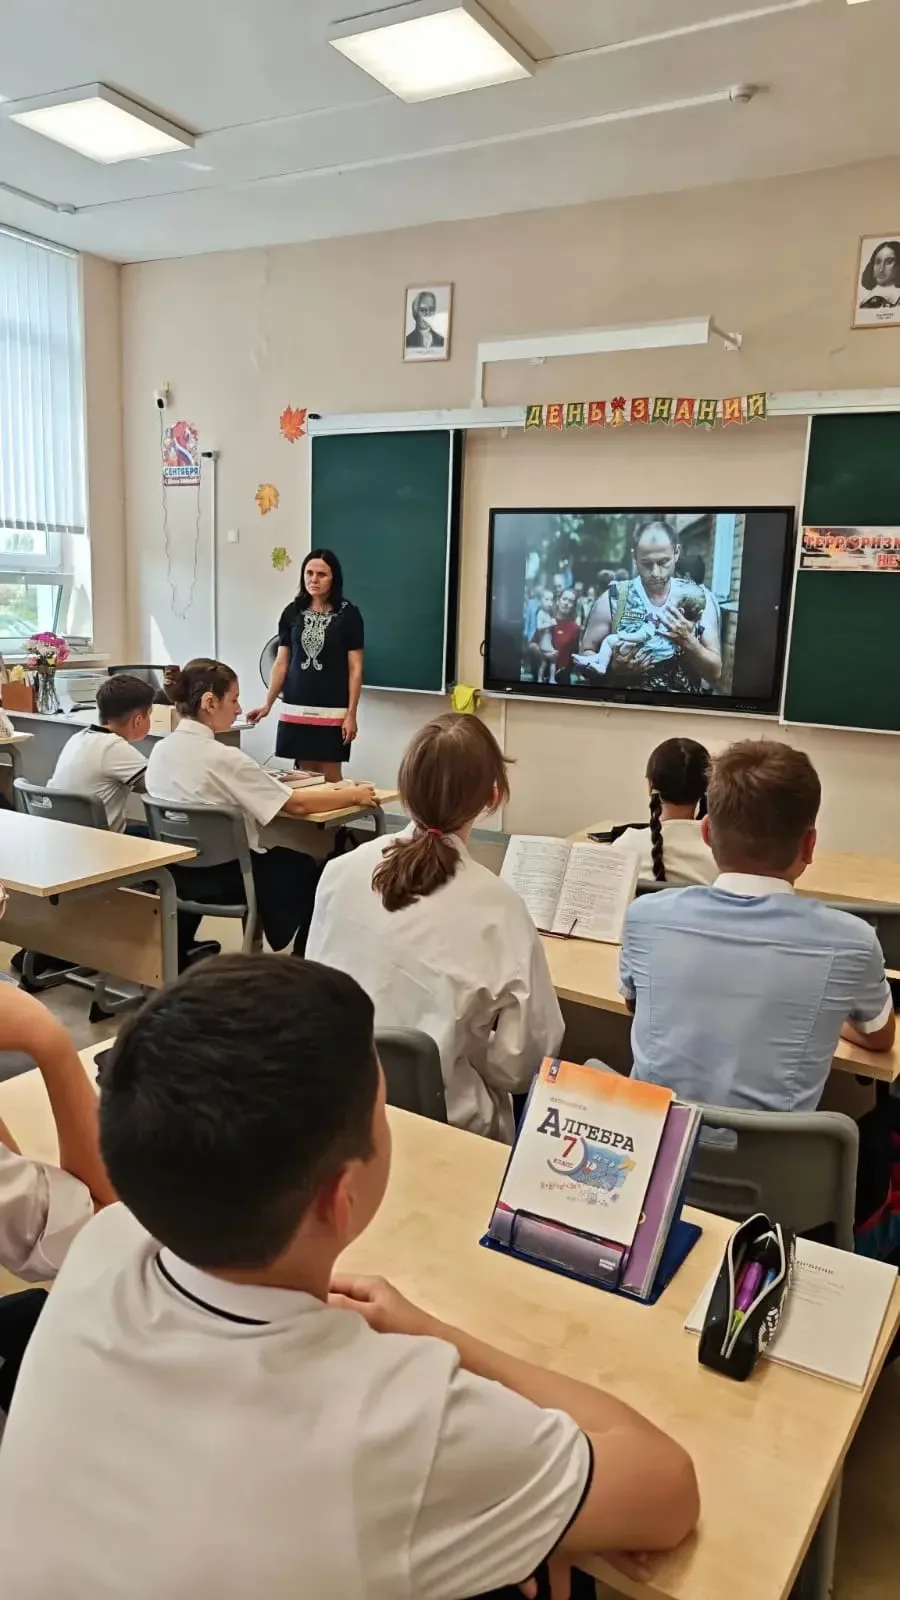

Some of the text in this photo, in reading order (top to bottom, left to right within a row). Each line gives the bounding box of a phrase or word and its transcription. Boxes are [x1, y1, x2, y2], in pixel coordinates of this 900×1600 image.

[527, 394, 766, 426] ДЕНЬ ЗНАНИЙ
[164, 466, 199, 476] СЕНТЯБРЯ
[563, 1135, 577, 1157] 7
